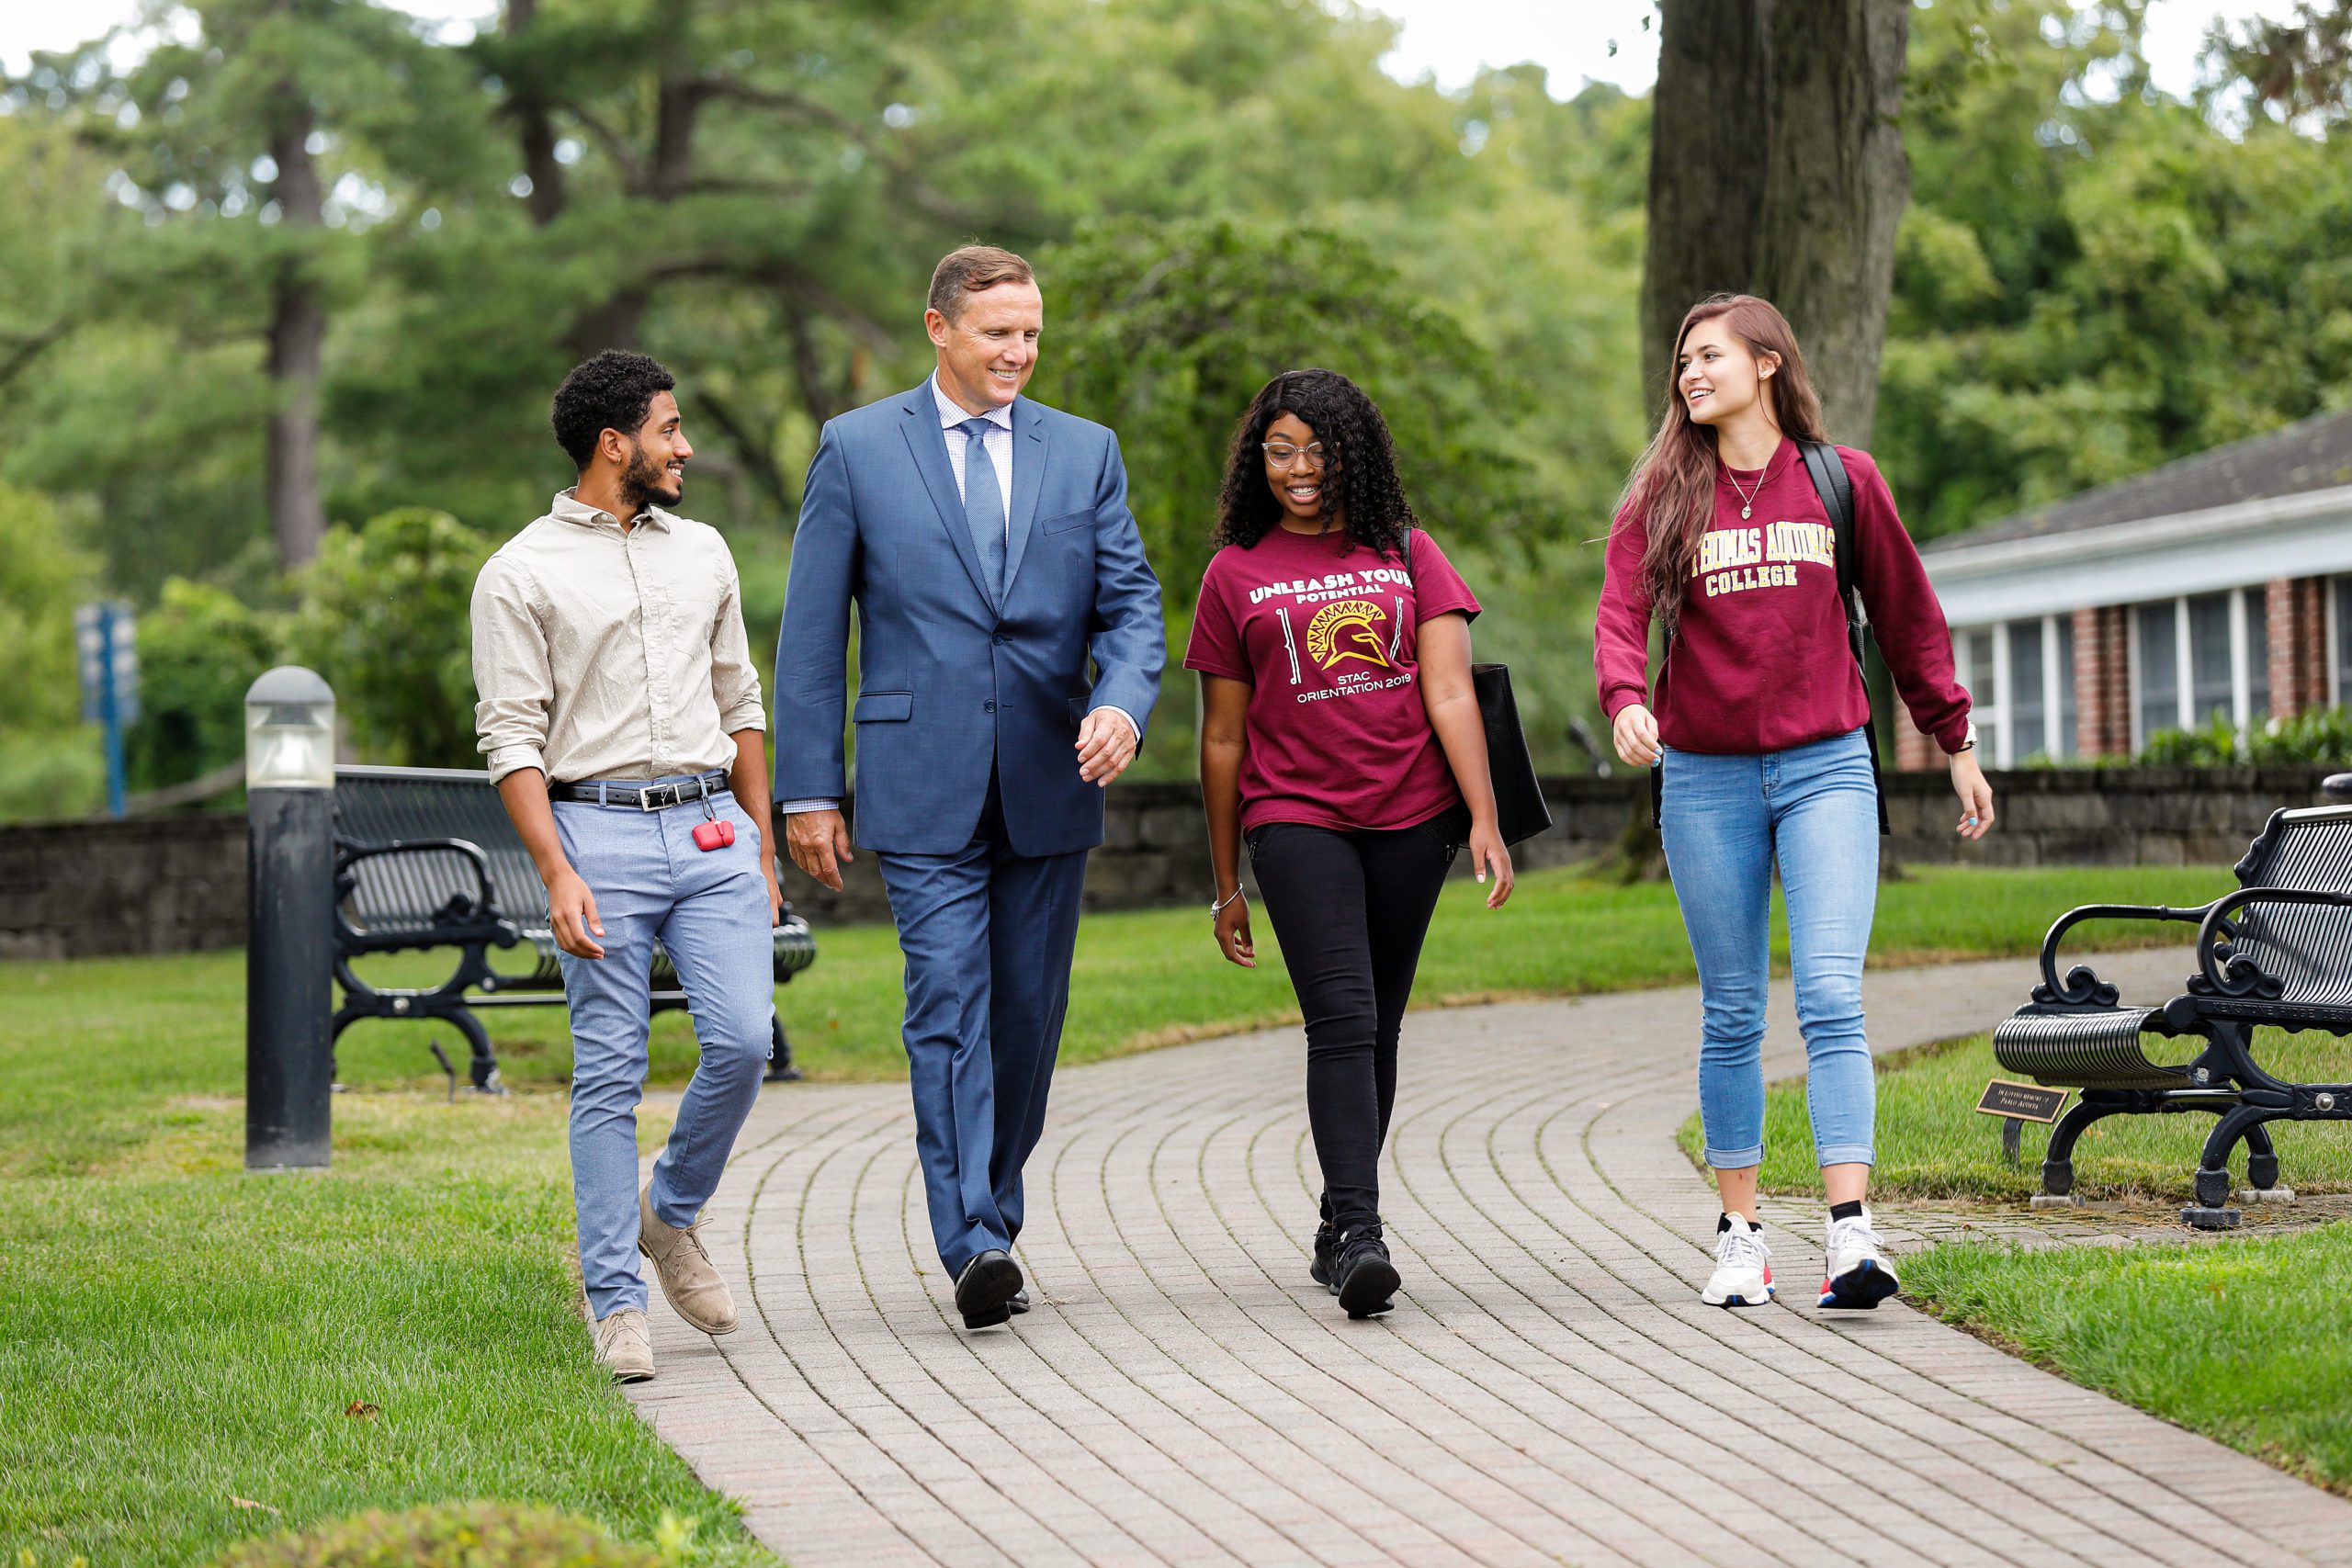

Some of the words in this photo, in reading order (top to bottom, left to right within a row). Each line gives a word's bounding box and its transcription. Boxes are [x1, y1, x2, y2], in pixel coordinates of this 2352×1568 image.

[1765, 521, 1836, 569] AQUINAS
[1249, 572, 1355, 604] UNLEASH
[1357, 569, 1413, 589] YOUR
[1295, 583, 1385, 604] POTENTIAL
[1705, 564, 1798, 597] COLLEGE
[1296, 678, 1385, 704] ORIENTATION
[1385, 672, 1412, 689] 2019
[1337, 671, 1372, 685] STAC
[2212, 1002, 2273, 1015] KEYSTONE
